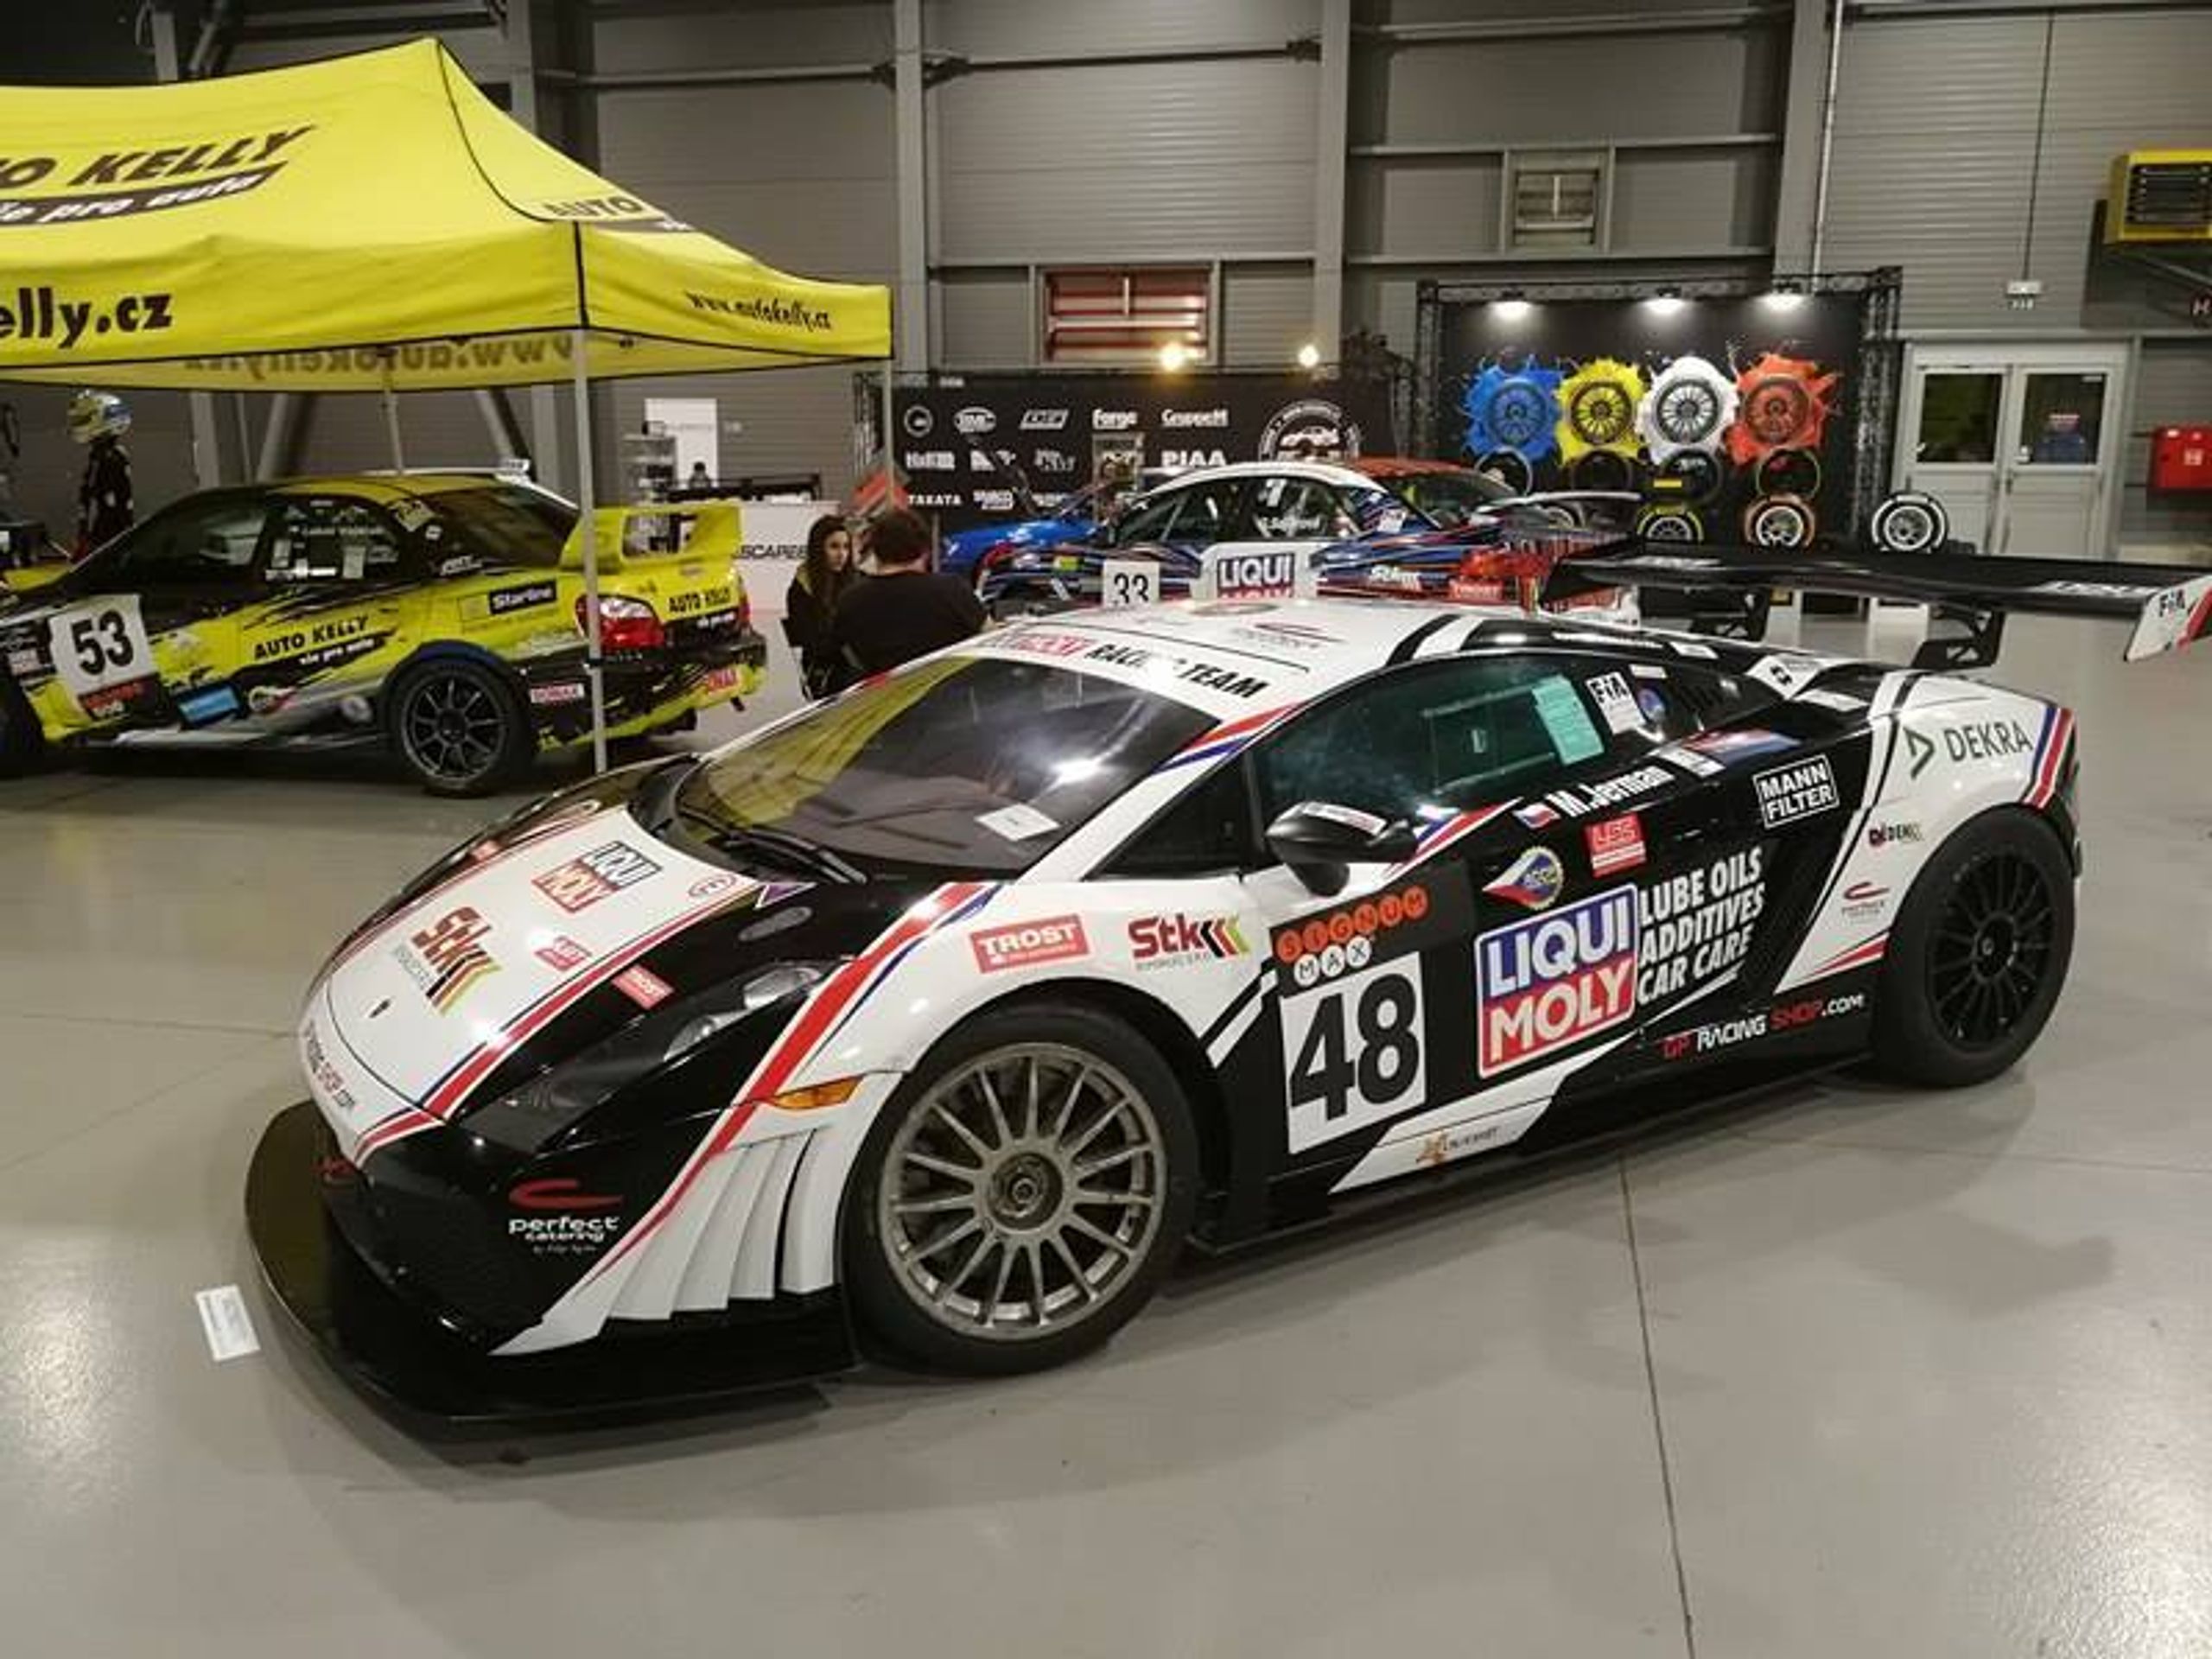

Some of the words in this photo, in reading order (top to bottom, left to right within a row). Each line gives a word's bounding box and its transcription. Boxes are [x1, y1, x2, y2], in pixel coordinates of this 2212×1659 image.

[67, 125, 317, 186] KELLY
[1161, 449, 1227, 467] PIAA
[907, 494, 963, 506] TAKATA
[1113, 572, 1149, 604] 33
[1219, 552, 1290, 588] LIQUI
[71, 610, 134, 675] 53
[254, 632, 306, 660] AUTO
[312, 614, 369, 644] KELLY
[1177, 663, 1271, 698] TEAM
[1944, 721, 2034, 761] DEKRA
[1758, 761, 1828, 800] MANN
[1765, 783, 1834, 822] FILTER
[1640, 873, 1706, 926] LUBE
[1710, 846, 1763, 899] OILS
[980, 925, 1078, 956] TROST
[1638, 882, 1766, 969] ADDITIVES
[1294, 935, 1372, 987] MAX
[1488, 895, 1630, 997] LIQUI
[1637, 962, 1686, 1005] CAR
[1692, 925, 1753, 976] CARE
[1489, 958, 1633, 1063] MOLY
[1290, 974, 1420, 1122] 48
[1695, 1014, 1768, 1052] RACING
[508, 1215, 620, 1236] perfect
